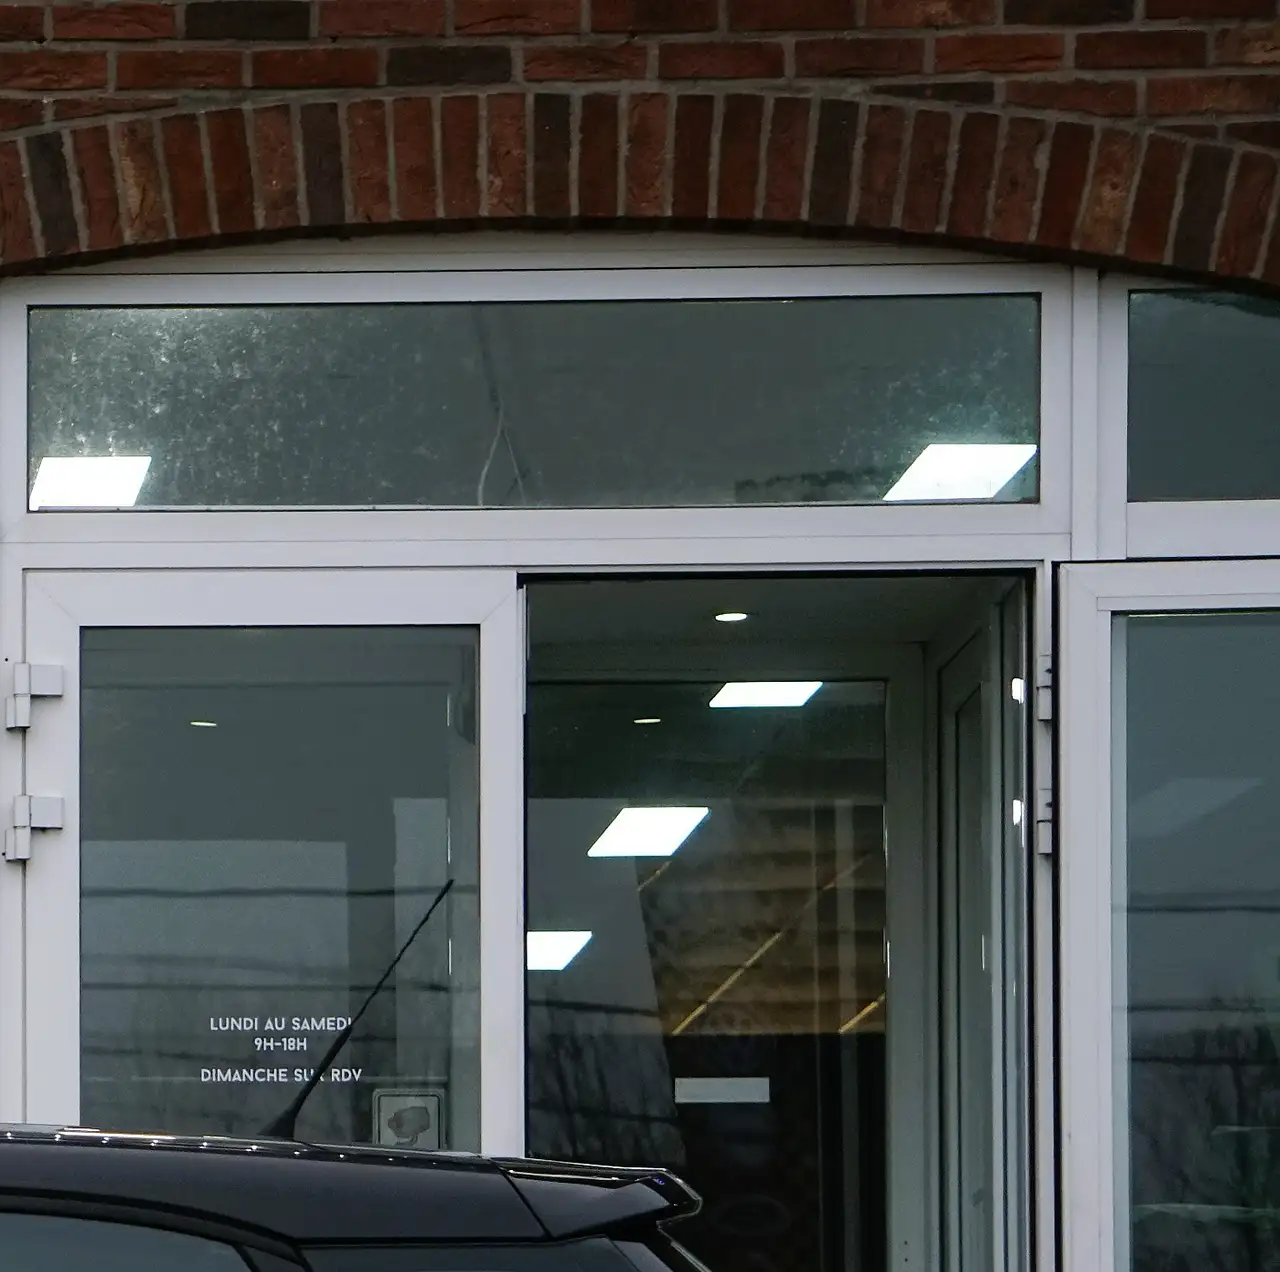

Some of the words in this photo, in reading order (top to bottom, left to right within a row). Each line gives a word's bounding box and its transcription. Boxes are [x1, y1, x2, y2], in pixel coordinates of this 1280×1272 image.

[210, 1017, 259, 1031] LUNDI
[264, 1017, 286, 1031] AU
[254, 1037, 307, 1051] 9H-18H
[200, 1068, 288, 1082] DIMANCHE
[331, 1068, 362, 1082] RDV
